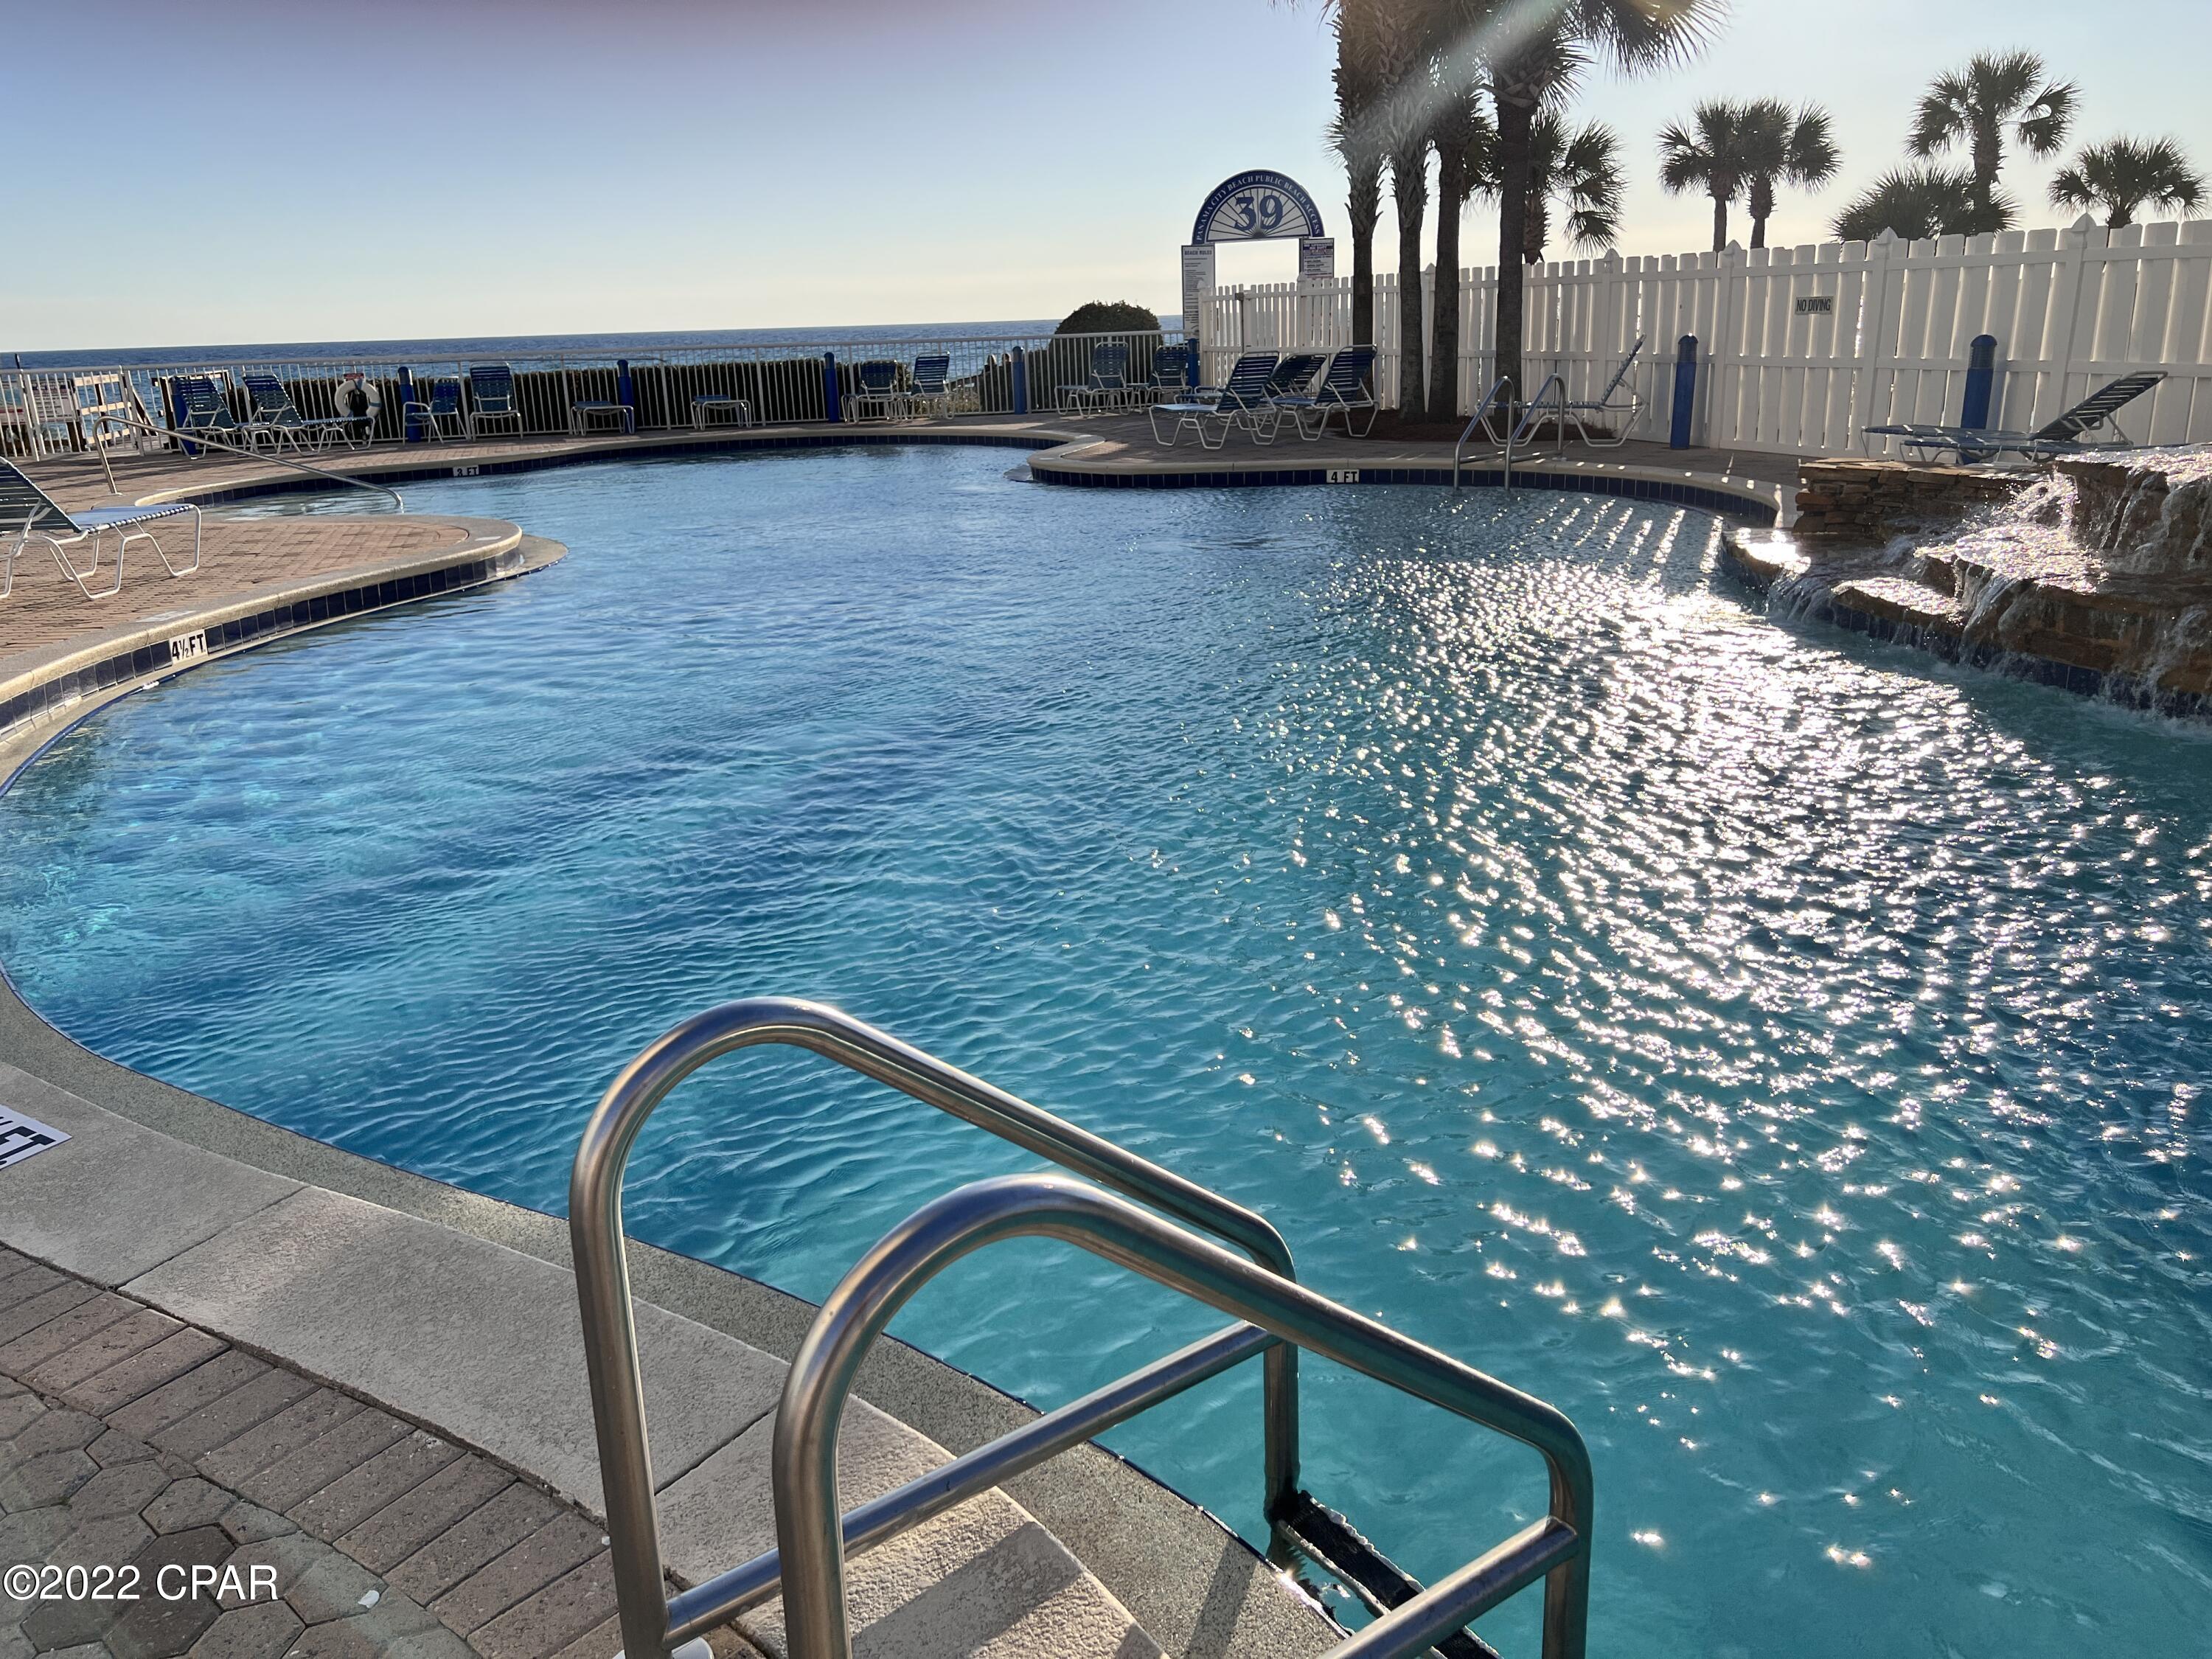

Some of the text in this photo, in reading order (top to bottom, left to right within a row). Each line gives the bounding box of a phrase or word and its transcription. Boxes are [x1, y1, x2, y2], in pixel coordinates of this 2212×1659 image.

[1197, 175, 1320, 240] PANAMA CITY BEACH PUBLIC BEACH ACCESS
[1234, 195, 1283, 231] 39
[1796, 298, 1831, 312] NO DIVING
[1331, 471, 1338, 484] 4
